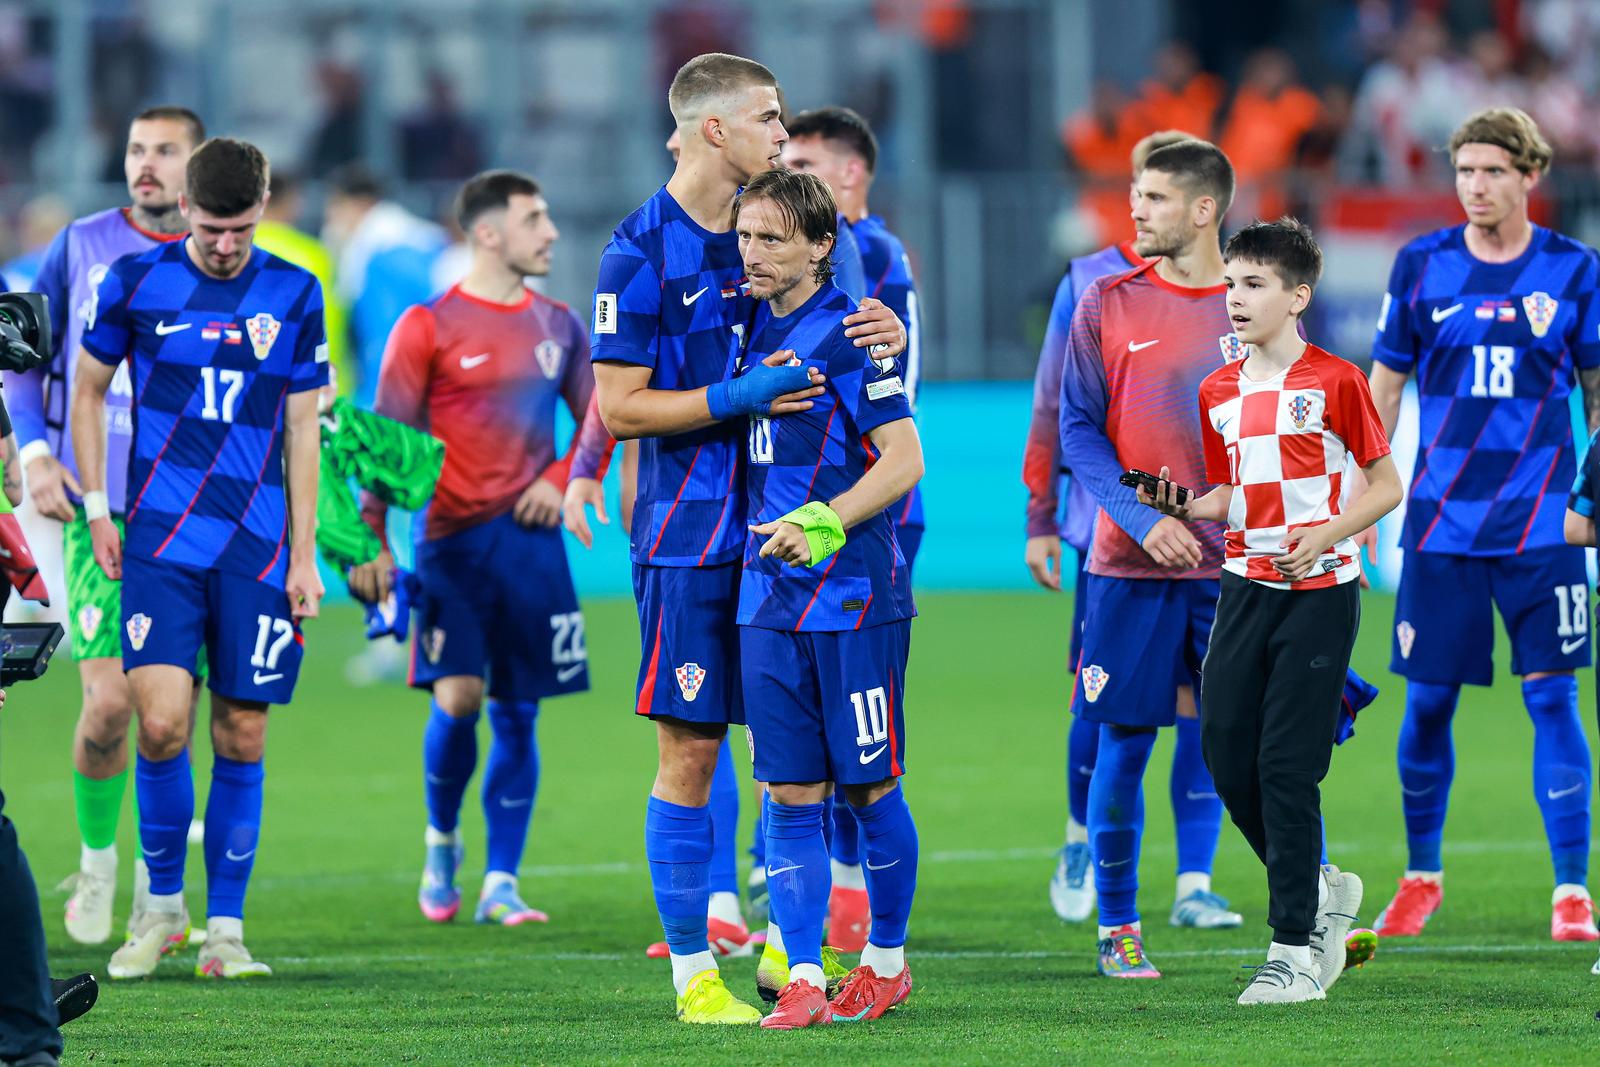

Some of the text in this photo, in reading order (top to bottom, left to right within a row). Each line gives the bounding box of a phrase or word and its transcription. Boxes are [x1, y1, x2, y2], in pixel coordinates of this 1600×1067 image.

[201, 366, 244, 423] 17
[1471, 345, 1515, 398] 18
[820, 529, 833, 558] SPECT
[1554, 583, 1588, 637] 18
[251, 614, 293, 669] 17
[550, 611, 587, 664] 22
[850, 686, 888, 747] 10
